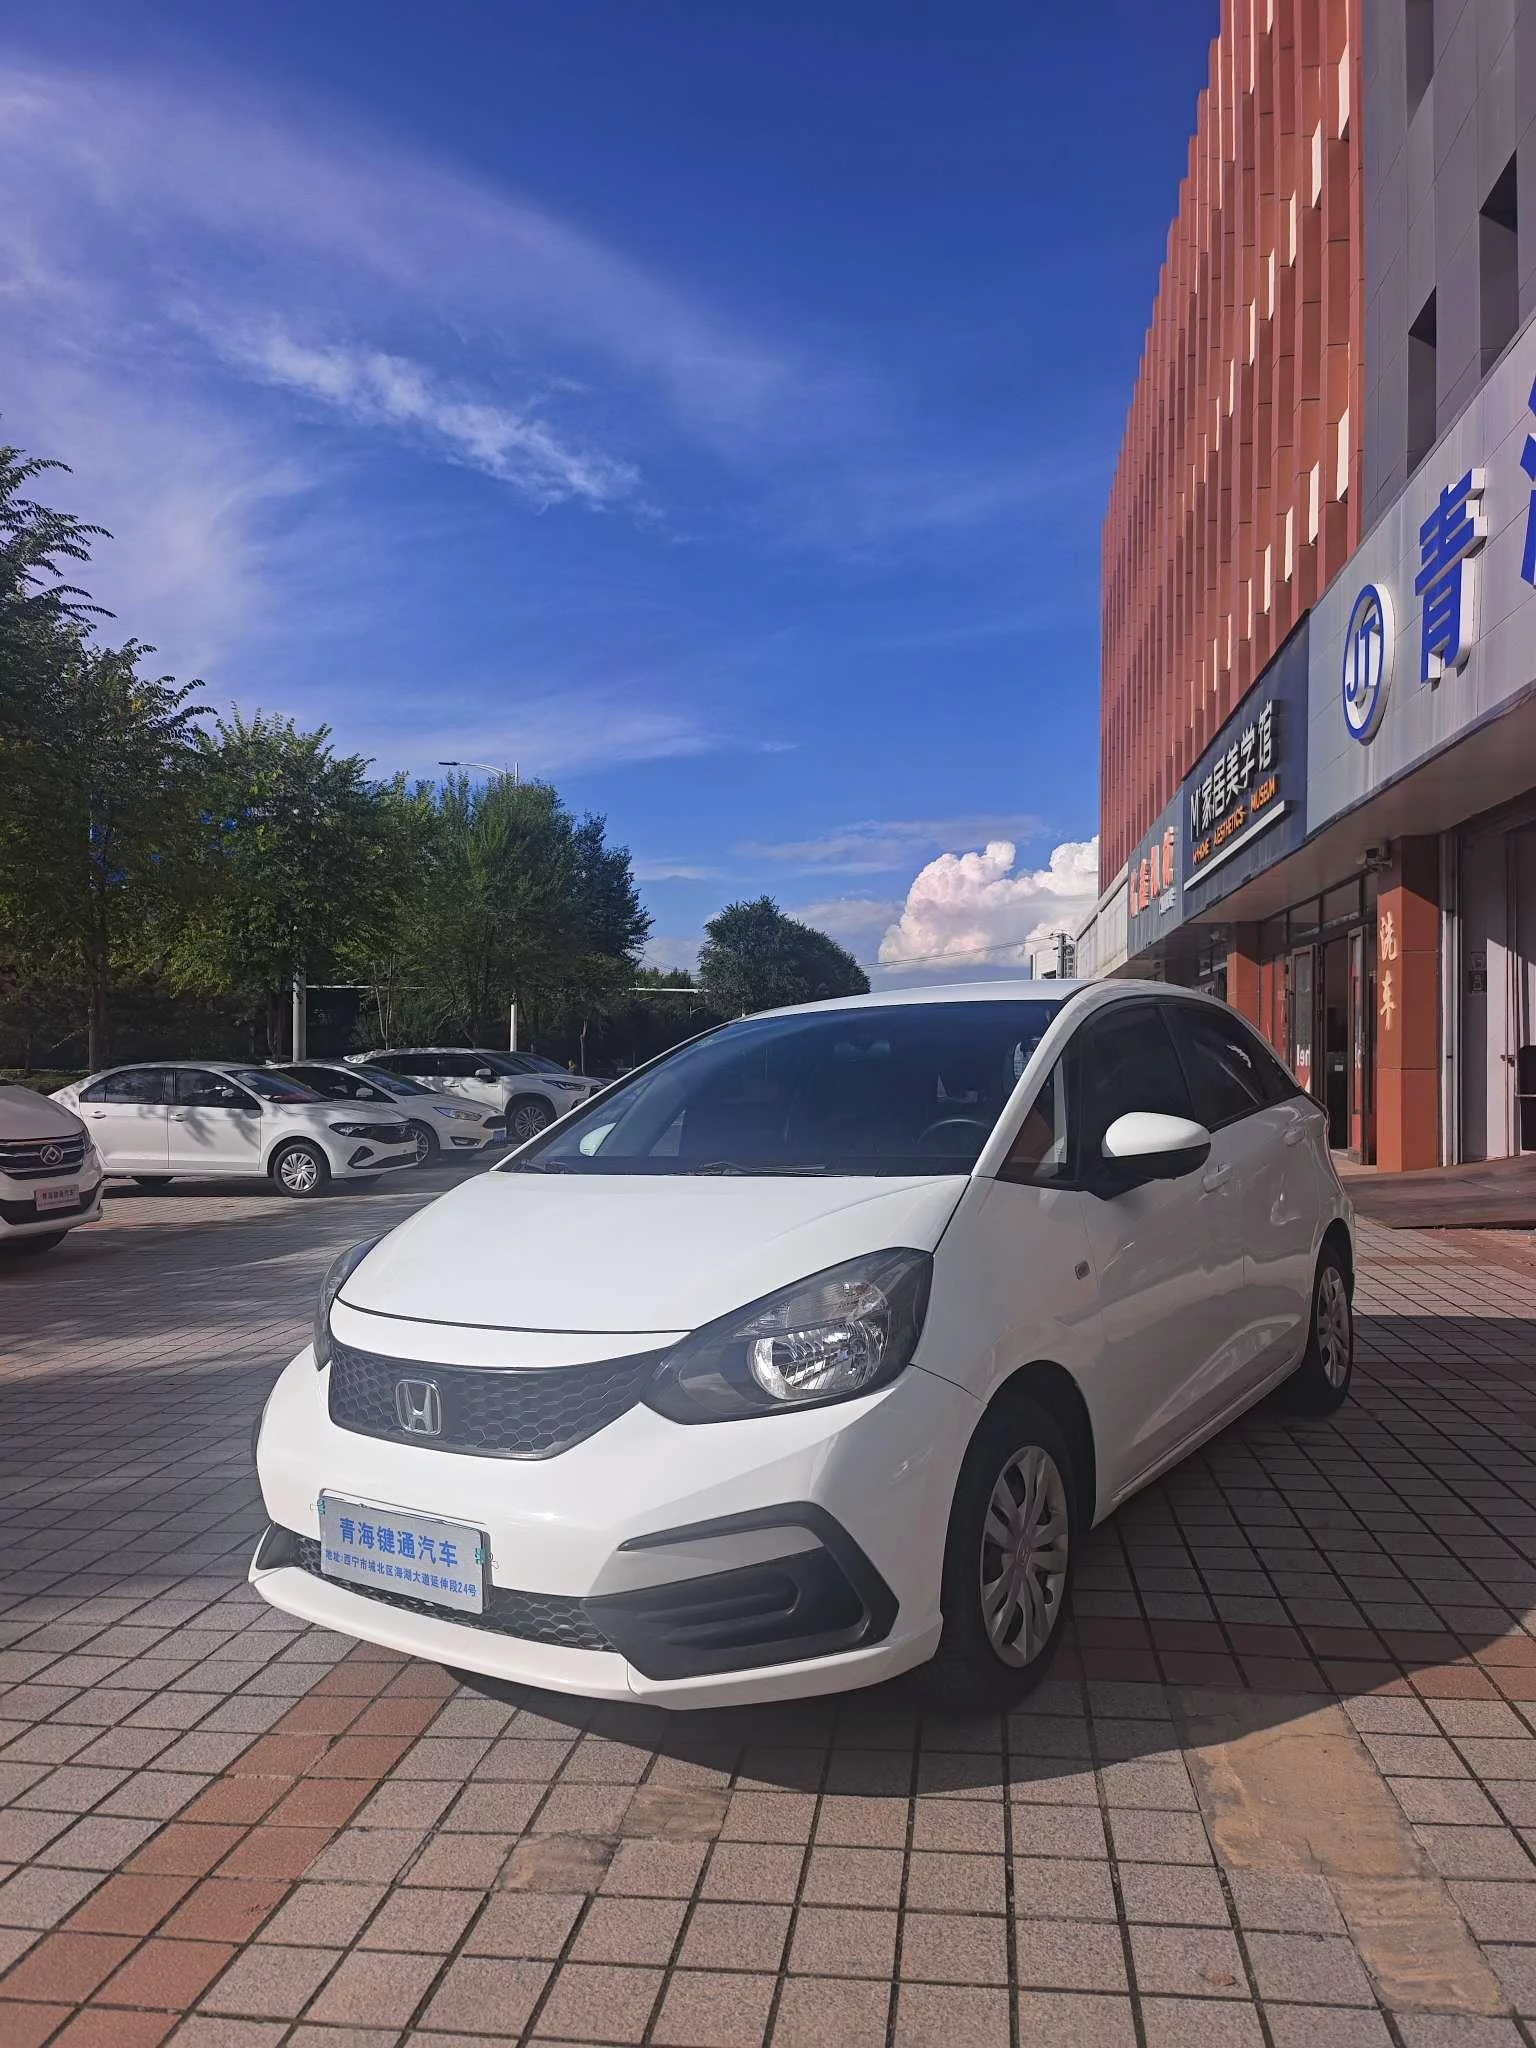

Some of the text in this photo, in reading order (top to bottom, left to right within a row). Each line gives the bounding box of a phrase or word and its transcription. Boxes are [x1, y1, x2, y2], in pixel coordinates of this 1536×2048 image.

[339, 1517, 458, 1568] 青海键通汽车
